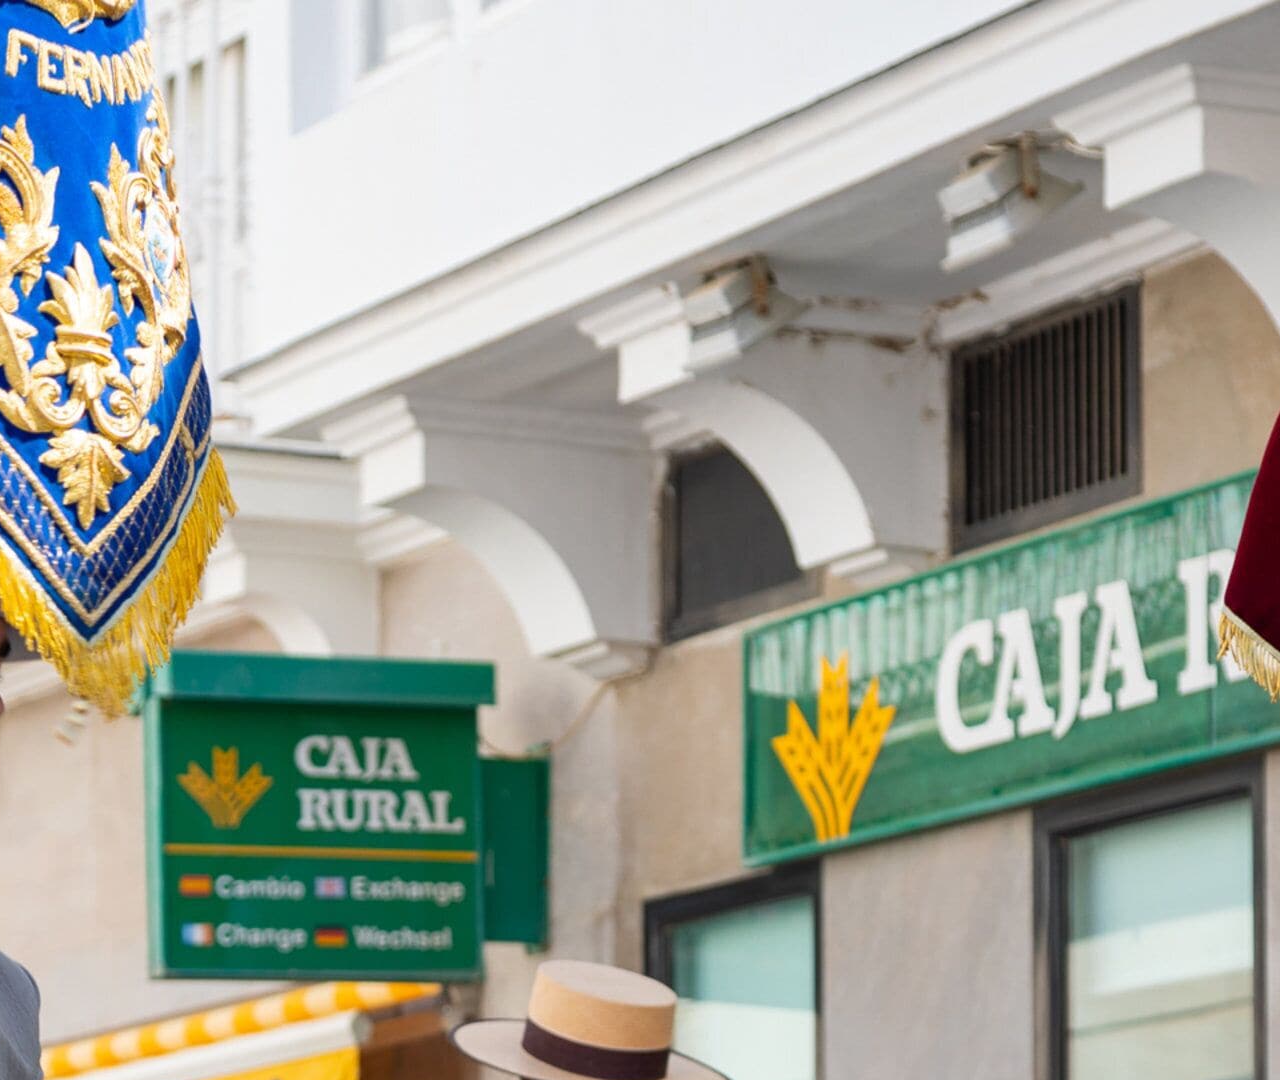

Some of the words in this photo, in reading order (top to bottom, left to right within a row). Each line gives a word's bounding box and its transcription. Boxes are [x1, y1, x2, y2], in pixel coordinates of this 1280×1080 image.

[935, 578, 1158, 754] CAJA
[294, 735, 420, 782] CAJA
[296, 788, 466, 834] RURAL
[214, 874, 306, 900] Cambio
[350, 875, 465, 906] Exchange
[216, 922, 307, 953] Change
[352, 925, 452, 949] Wechsel
